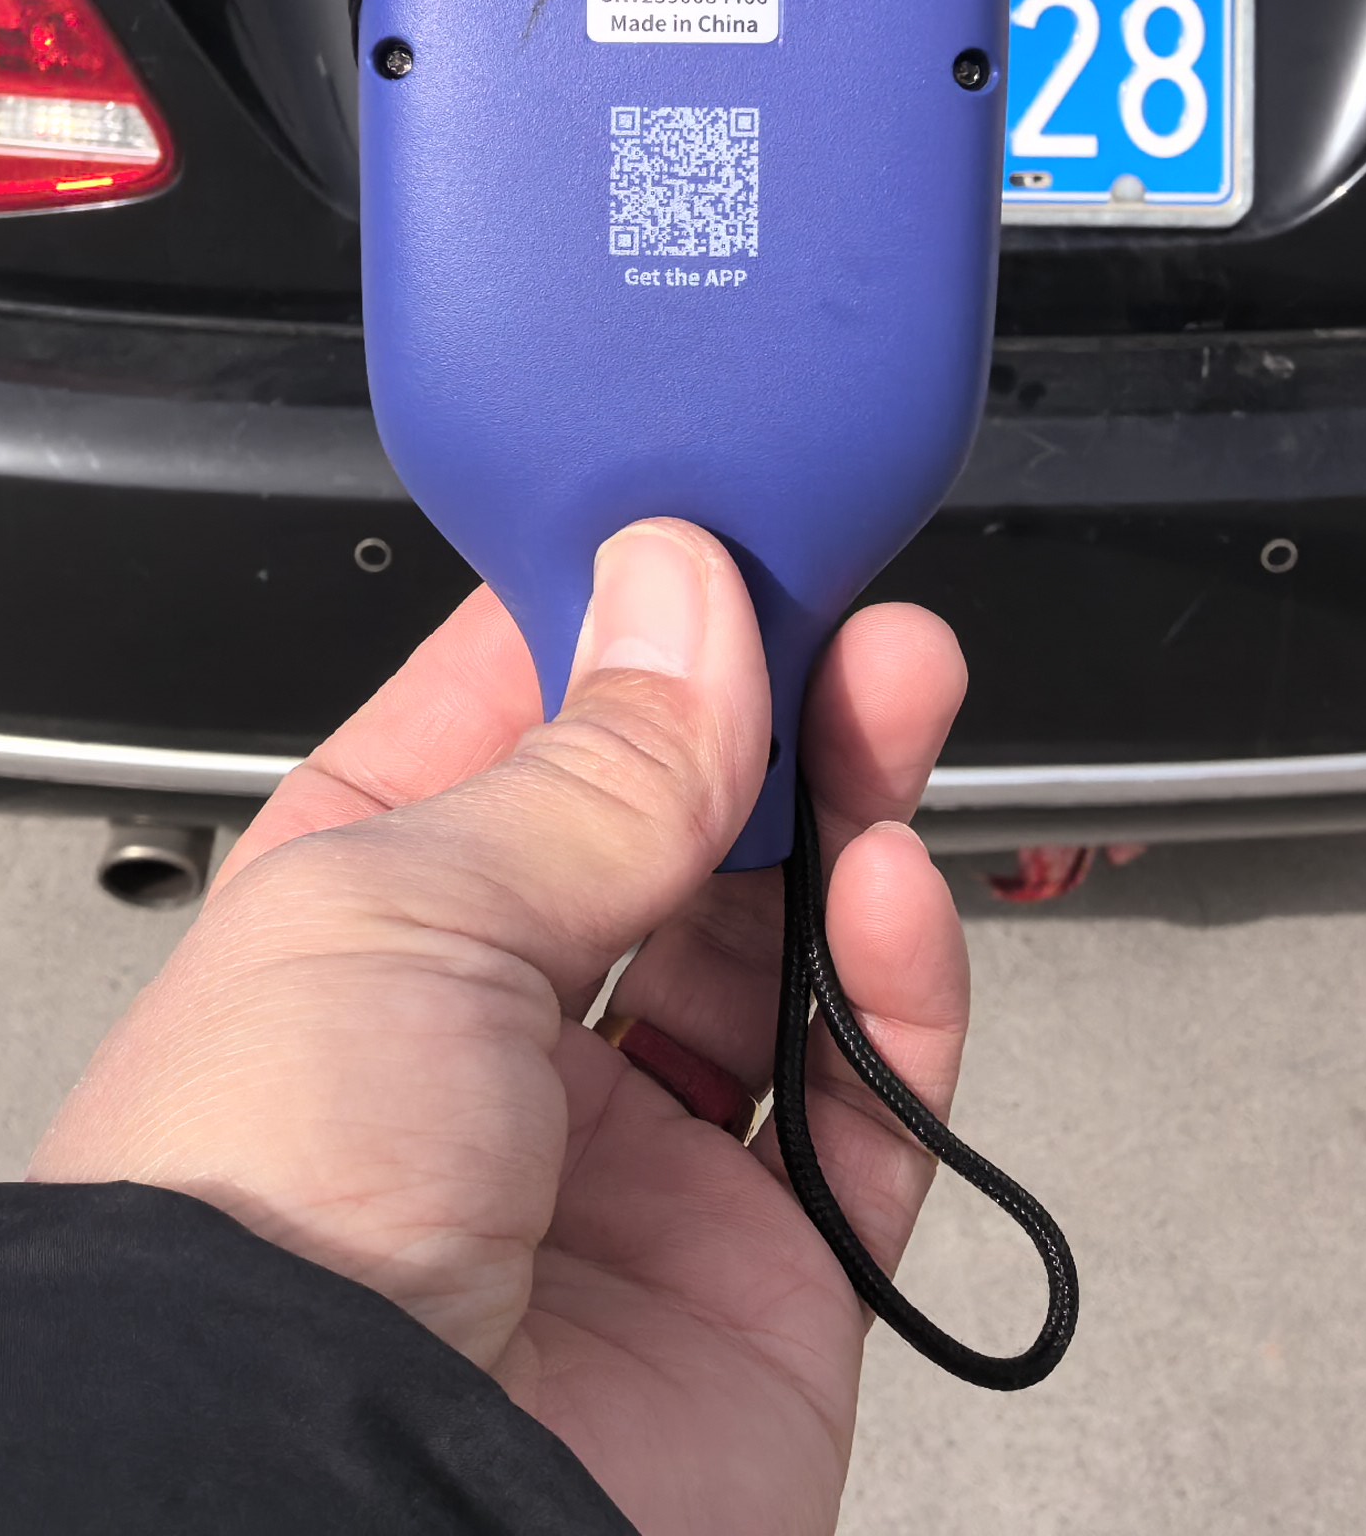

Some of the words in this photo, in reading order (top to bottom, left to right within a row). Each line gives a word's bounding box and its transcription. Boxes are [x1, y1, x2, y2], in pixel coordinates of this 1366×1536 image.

[611, 14, 667, 33] Made
[673, 14, 692, 33] in
[698, 14, 759, 34] China
[624, 267, 661, 287] Get
[665, 267, 701, 287] the
[705, 269, 748, 287] APP
